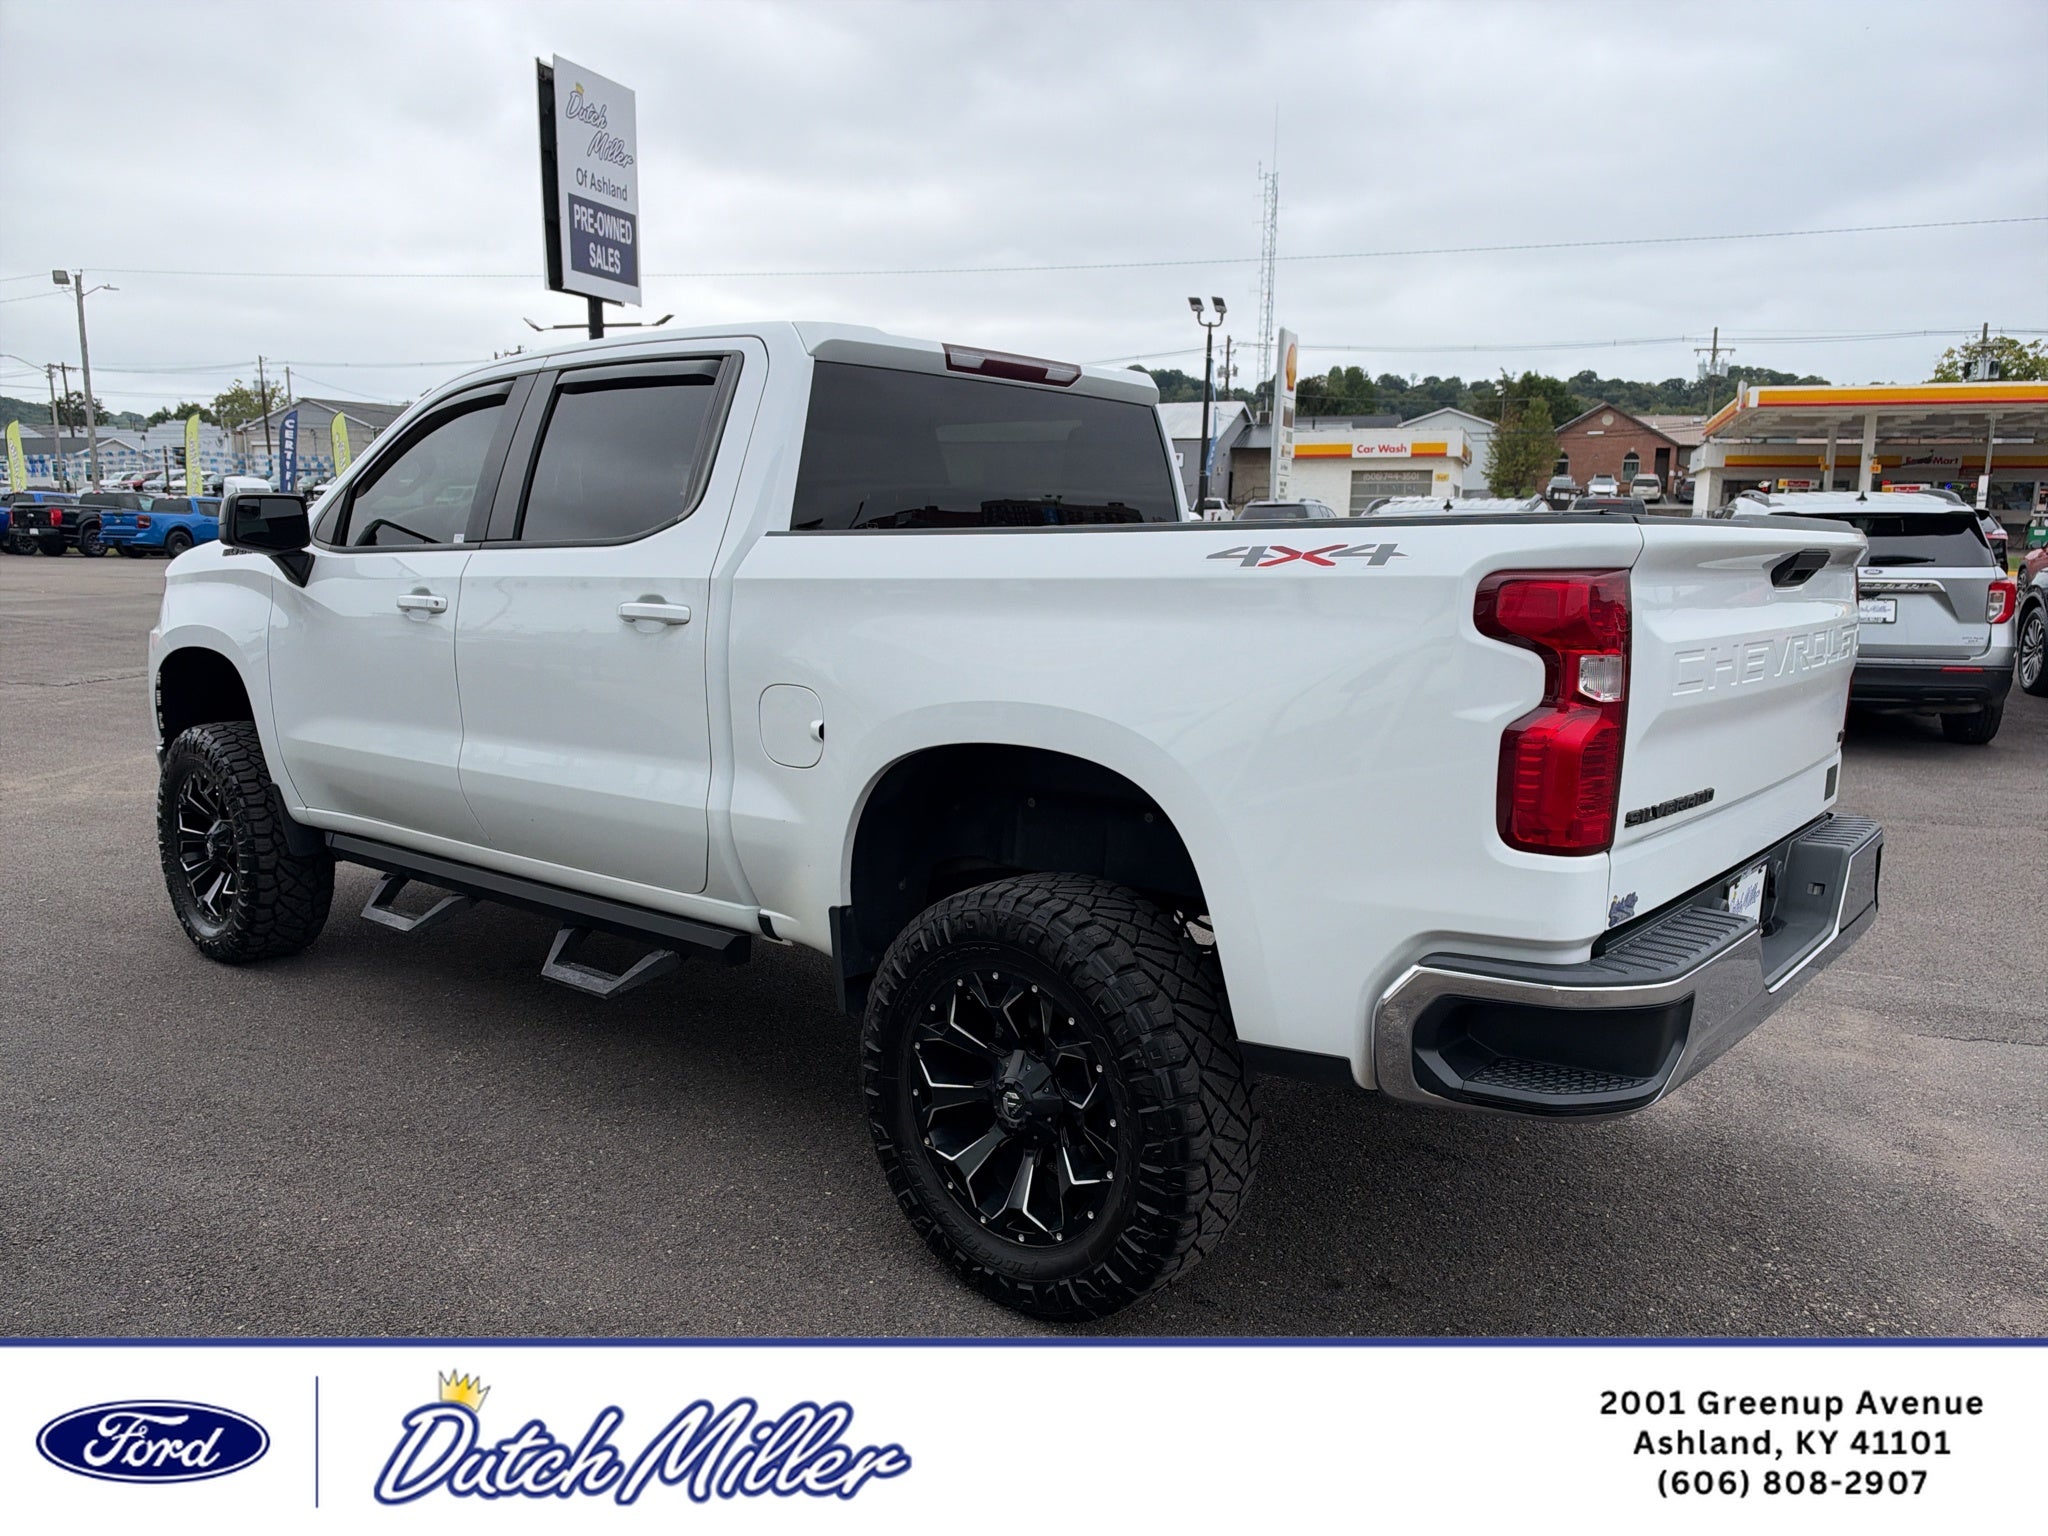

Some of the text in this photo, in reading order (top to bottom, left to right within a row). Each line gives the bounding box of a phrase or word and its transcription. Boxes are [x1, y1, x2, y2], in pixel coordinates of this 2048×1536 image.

[565, 91, 607, 129] Dutch
[587, 131, 634, 168] Miller
[576, 168, 628, 201] Of Ashland
[573, 203, 633, 245] PRE-OWNED
[588, 242, 621, 274] SALES
[1356, 443, 1407, 454] Car Wash
[1671, 622, 1859, 697] CHEVROLET
[1624, 788, 1715, 828] SILVERADO
